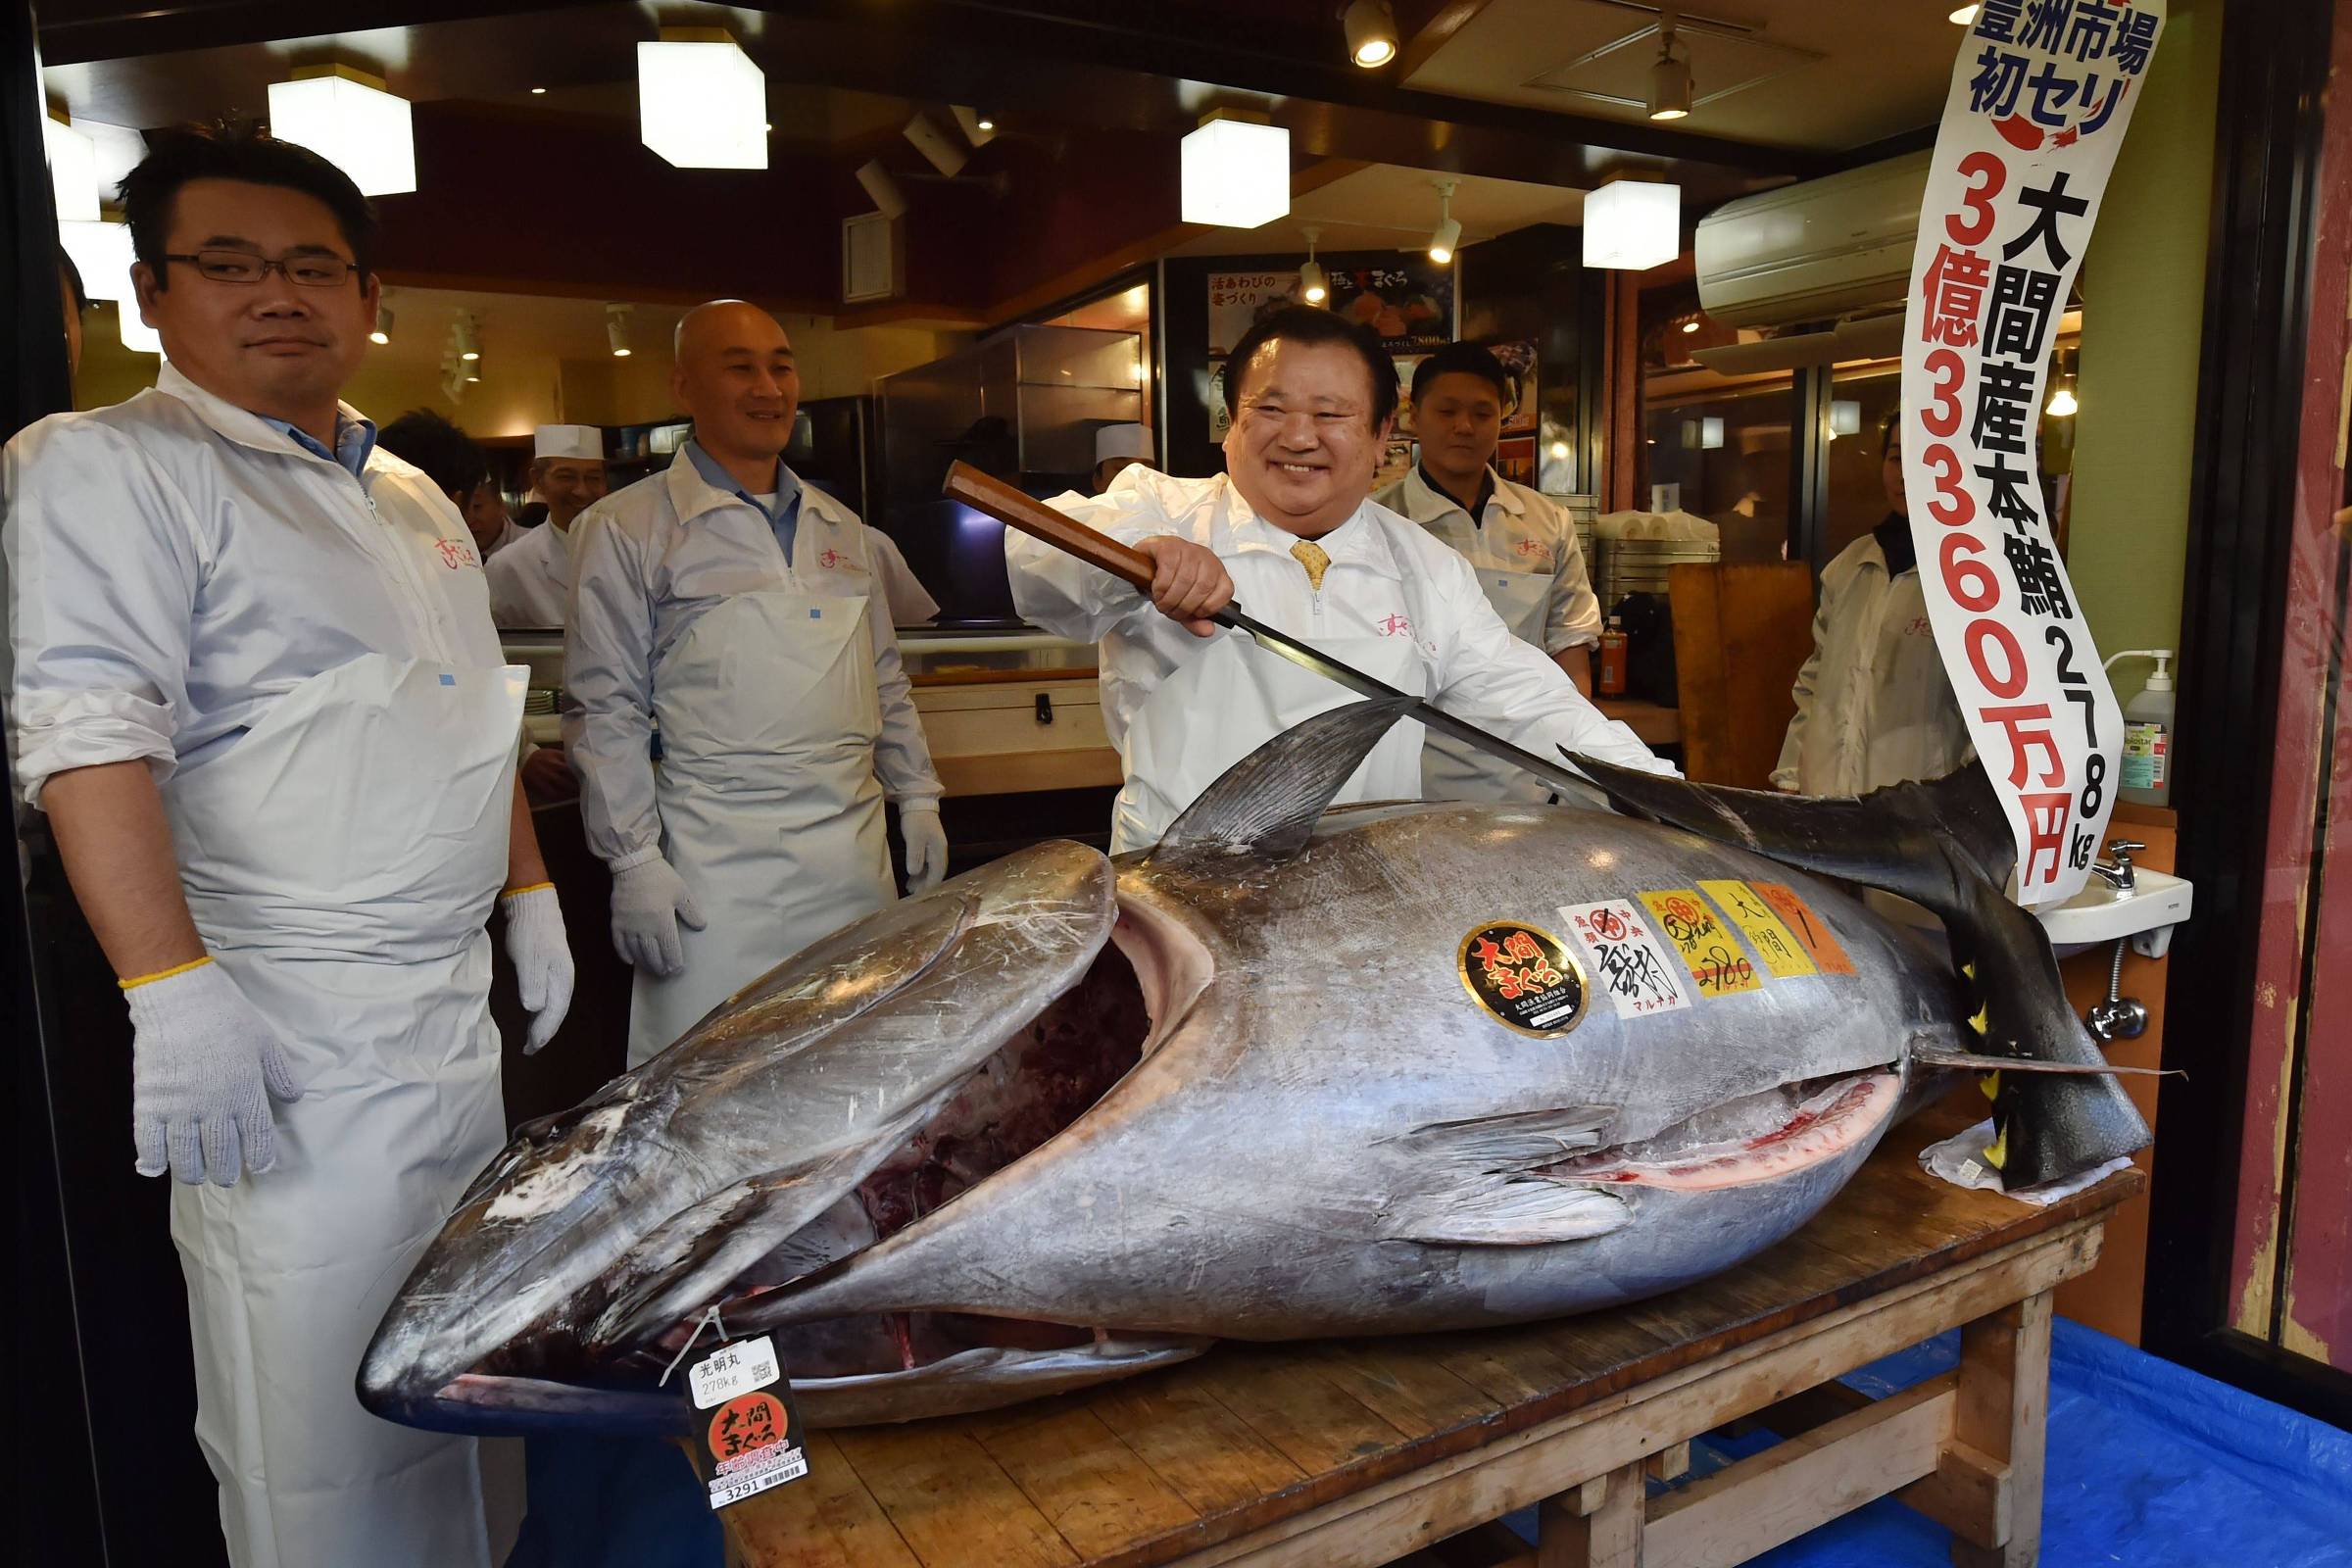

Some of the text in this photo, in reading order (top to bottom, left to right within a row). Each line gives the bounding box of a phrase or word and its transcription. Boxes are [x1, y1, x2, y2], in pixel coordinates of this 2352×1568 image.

[1973, 0, 2159, 74] 豊洲市場
[1970, 45, 2124, 135] 初セリ
[1211, 275, 1276, 290] 活あわびの
[1920, 150, 2072, 887] 3億3360万円
[1471, 931, 1545, 971] 大間
[1488, 957, 1564, 999] まぐろ
[699, 1353, 741, 1379] 光明丸
[720, 1401, 772, 1435] 大間
[721, 1424, 777, 1456] まぐろ
[726, 1480, 760, 1501] 3291
